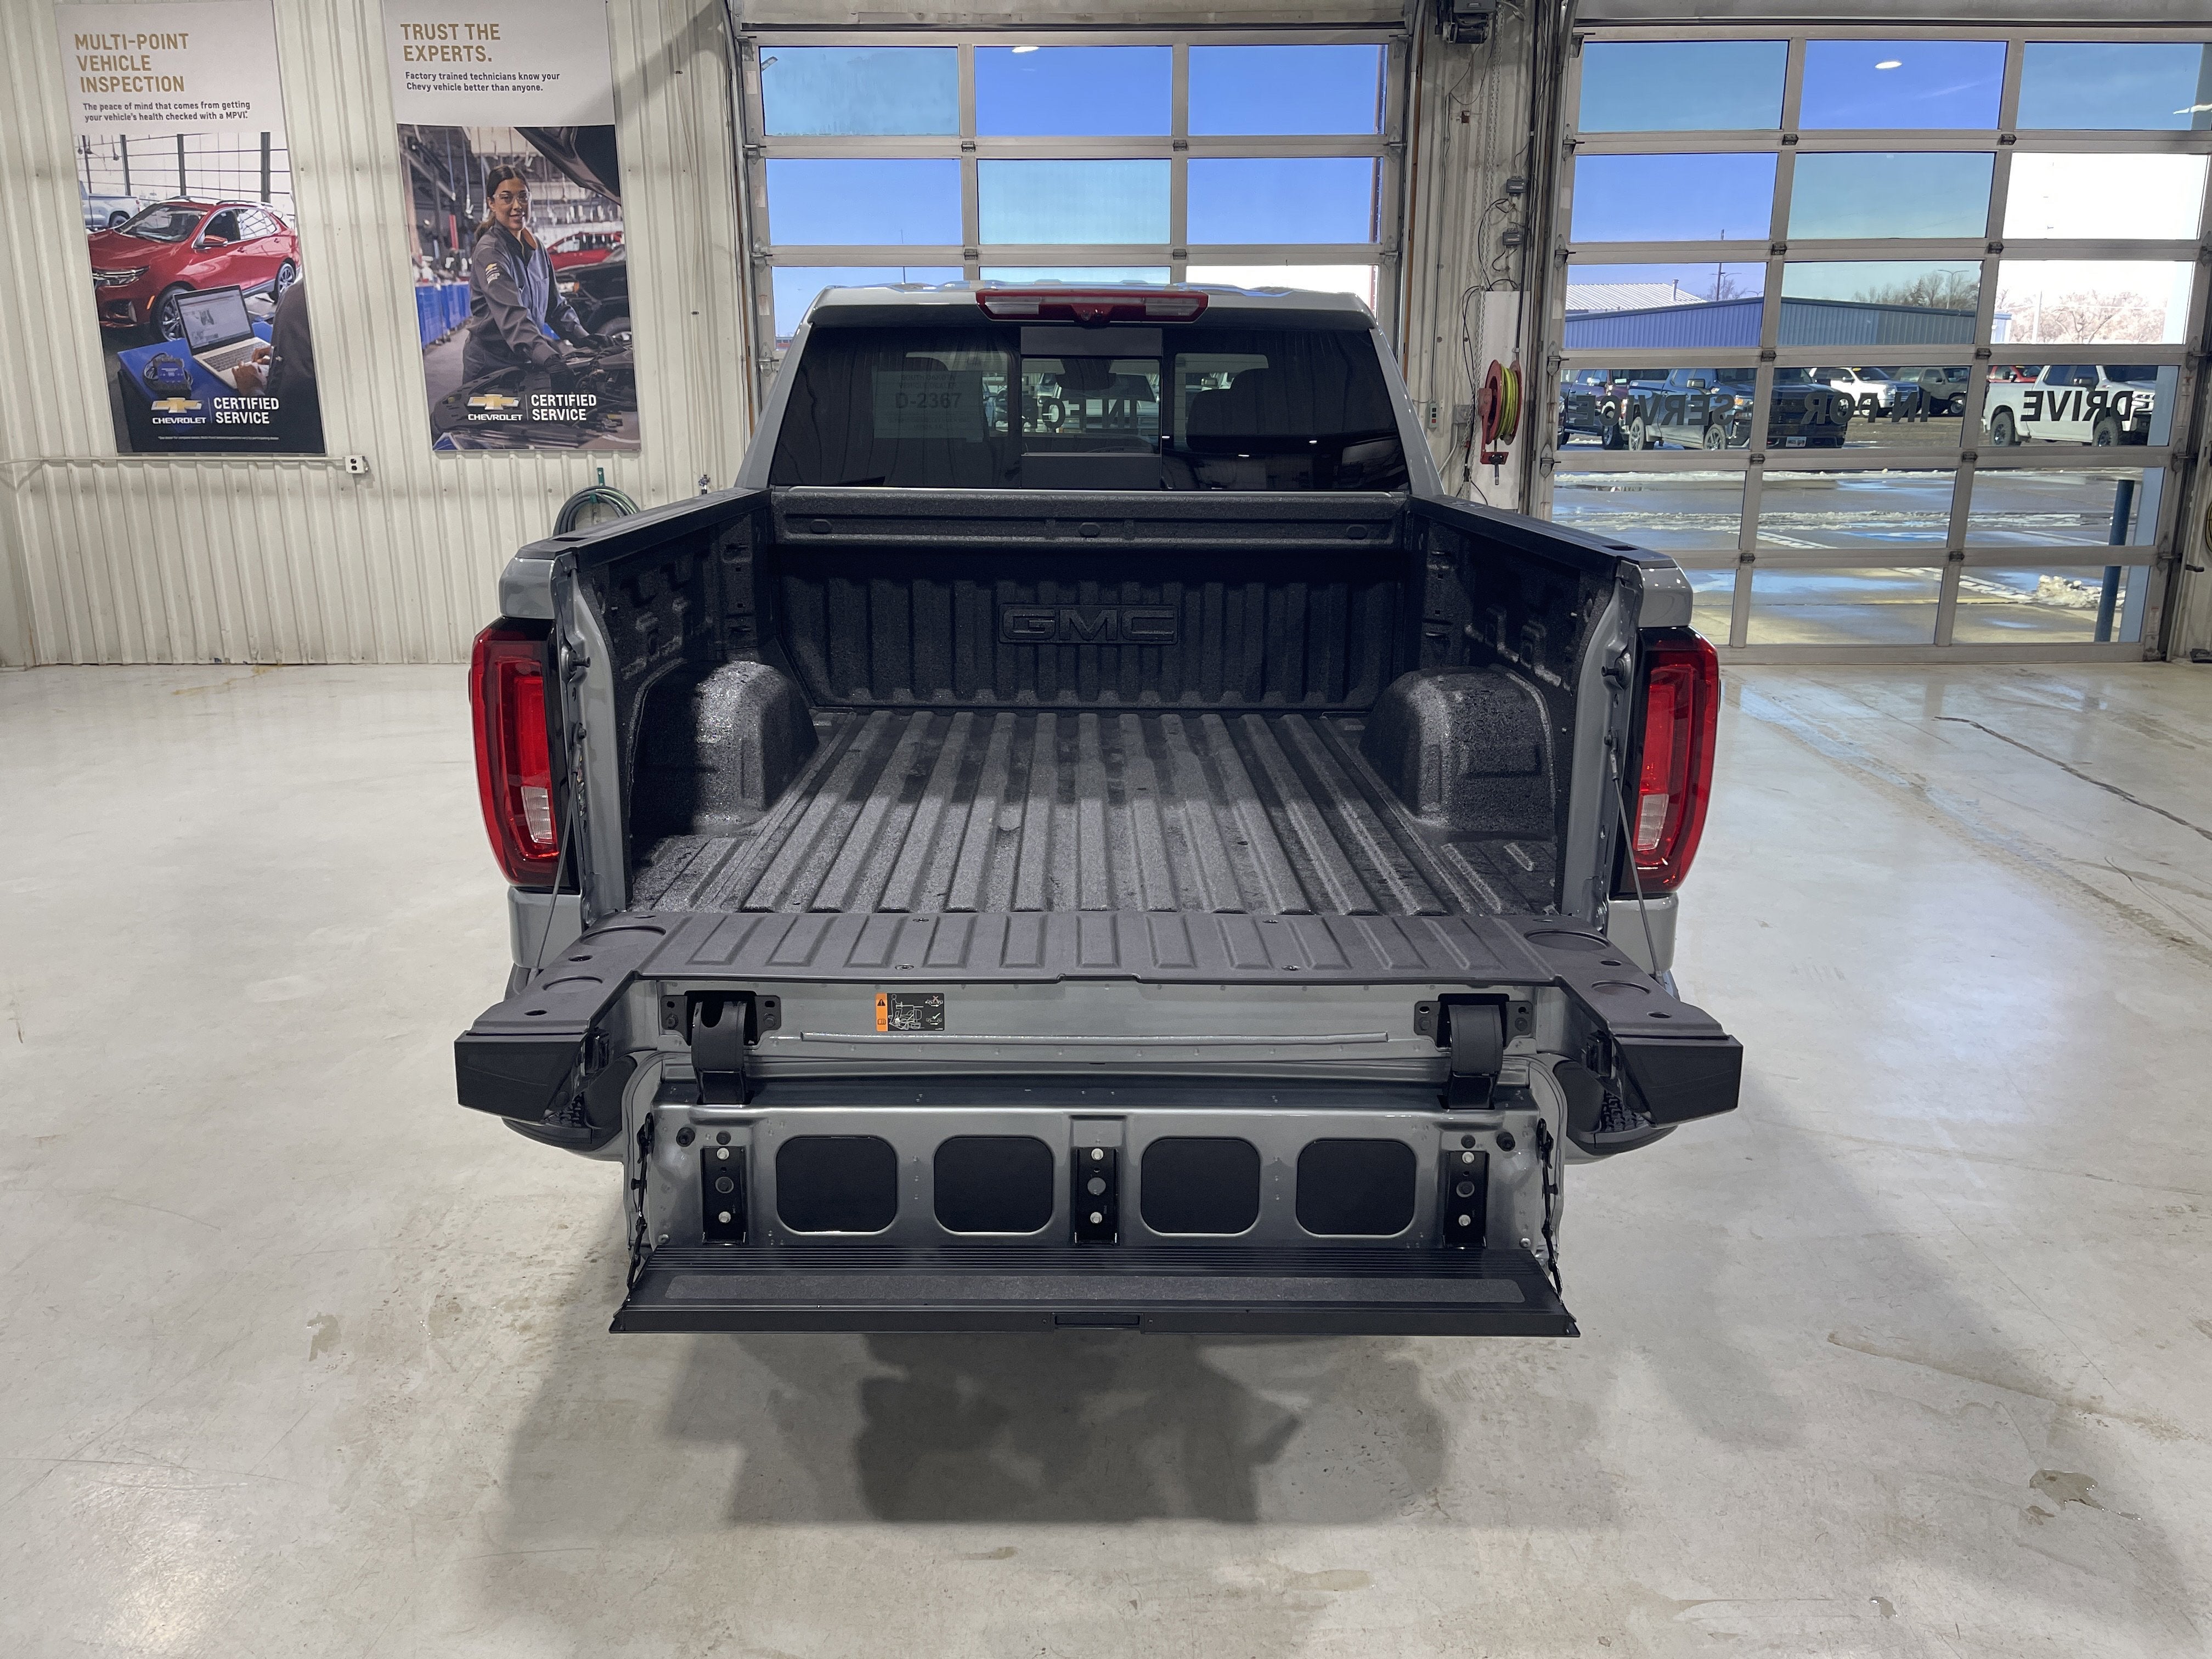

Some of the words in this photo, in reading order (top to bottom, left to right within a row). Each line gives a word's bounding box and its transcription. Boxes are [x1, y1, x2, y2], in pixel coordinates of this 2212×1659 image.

[400, 24, 459, 40] TRUST
[464, 24, 500, 40] THE
[75, 33, 189, 50] MULTI-POINT
[403, 45, 493, 62] EXPERTS.
[76, 55, 151, 71] VEHICLE
[405, 71, 437, 81] Factory
[439, 72, 467, 80] trained
[470, 72, 516, 80] technicians
[518, 72, 540, 80] know
[541, 74, 560, 82] your
[80, 76, 185, 93] INSPECTION
[407, 82, 431, 92] Chevy
[433, 83, 462, 91] vehicle
[464, 83, 489, 91] better
[512, 84, 543, 93] anyone.
[83, 103, 97, 111] The
[100, 104, 122, 112] peace
[155, 101, 172, 110] that
[201, 101, 219, 109] from
[222, 100, 250, 110] getting
[84, 115, 102, 123] your
[104, 112, 137, 121] vehicle's
[139, 112, 163, 121] health
[166, 112, 198, 120] checked
[200, 111, 217, 120] with
[213, 397, 280, 410] CERTIFIED
[531, 394, 597, 407] CERTIFIED
[895, 392, 962, 409] D-2367
[215, 411, 270, 424] SERVICE
[532, 408, 586, 421] SERVICE
[1002, 608, 1174, 641] GMC
